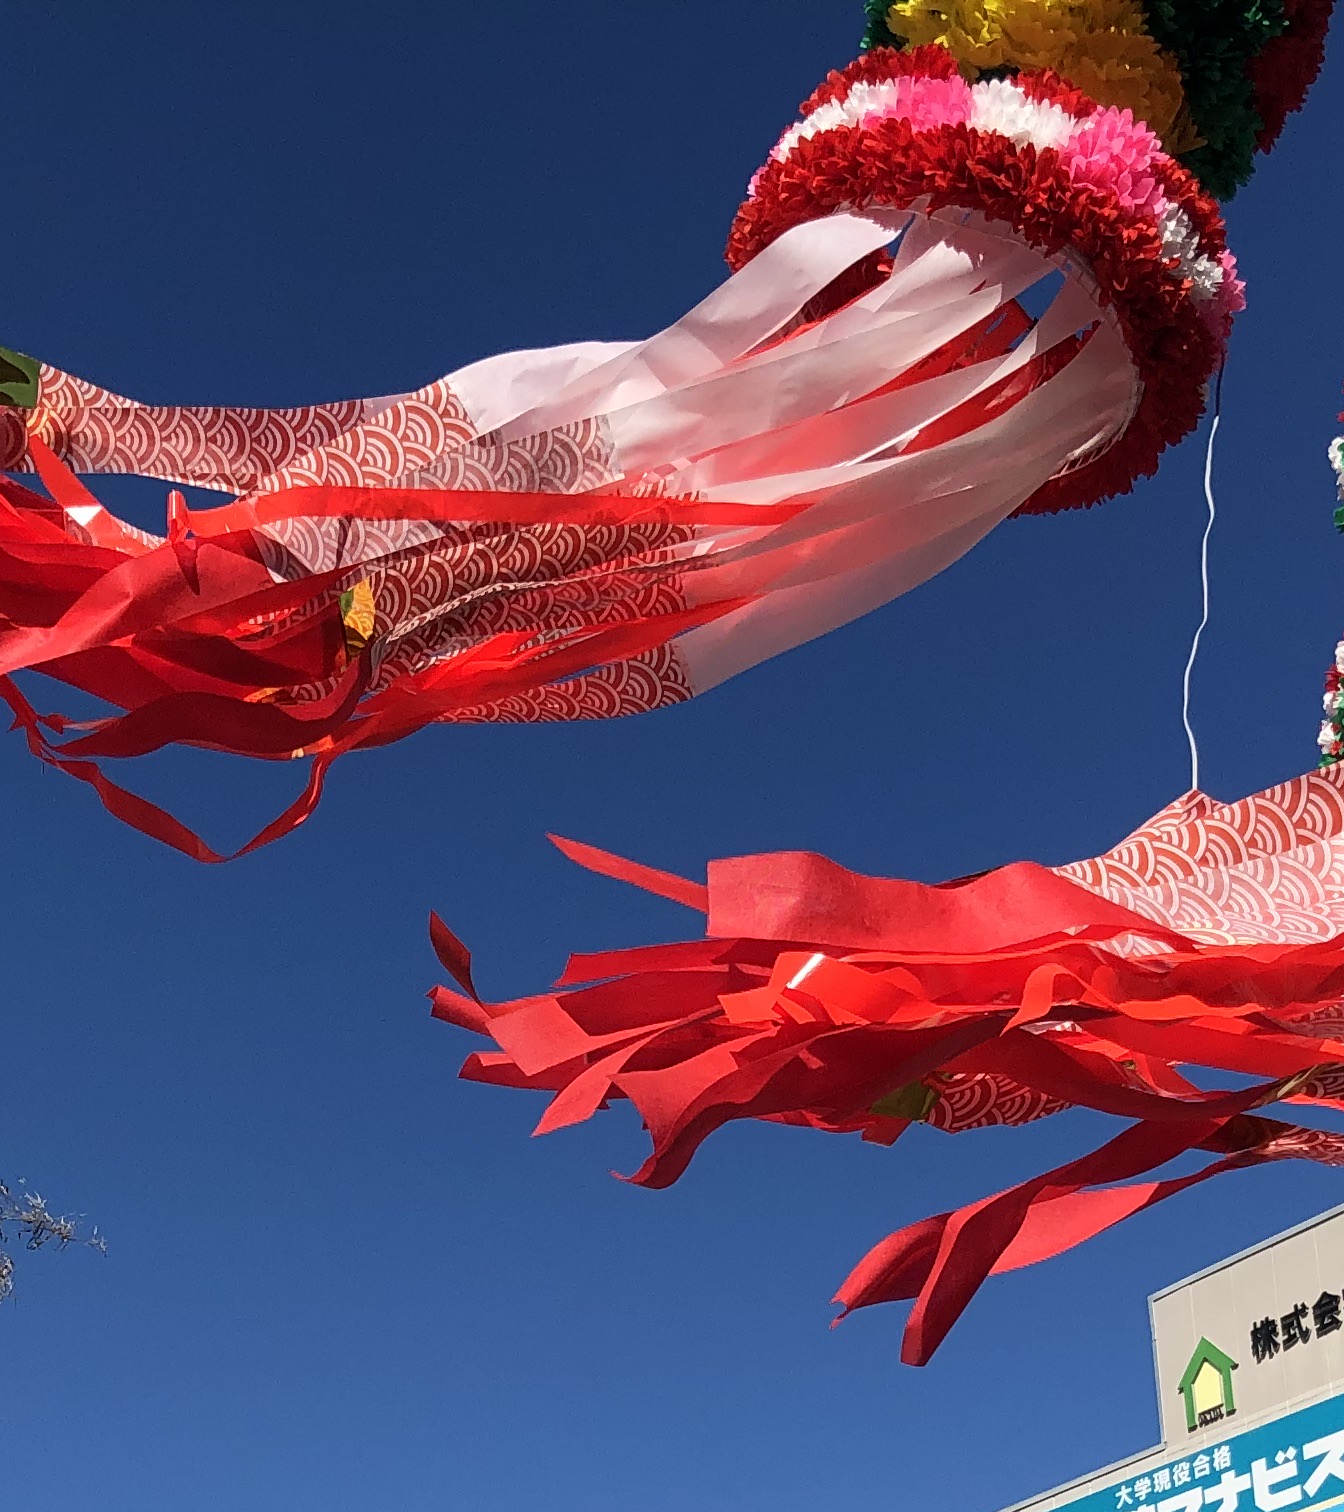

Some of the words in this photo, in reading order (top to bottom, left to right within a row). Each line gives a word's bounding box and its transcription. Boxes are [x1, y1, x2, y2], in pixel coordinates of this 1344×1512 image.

[1115, 1445, 1231, 1509] 大学現役合格
